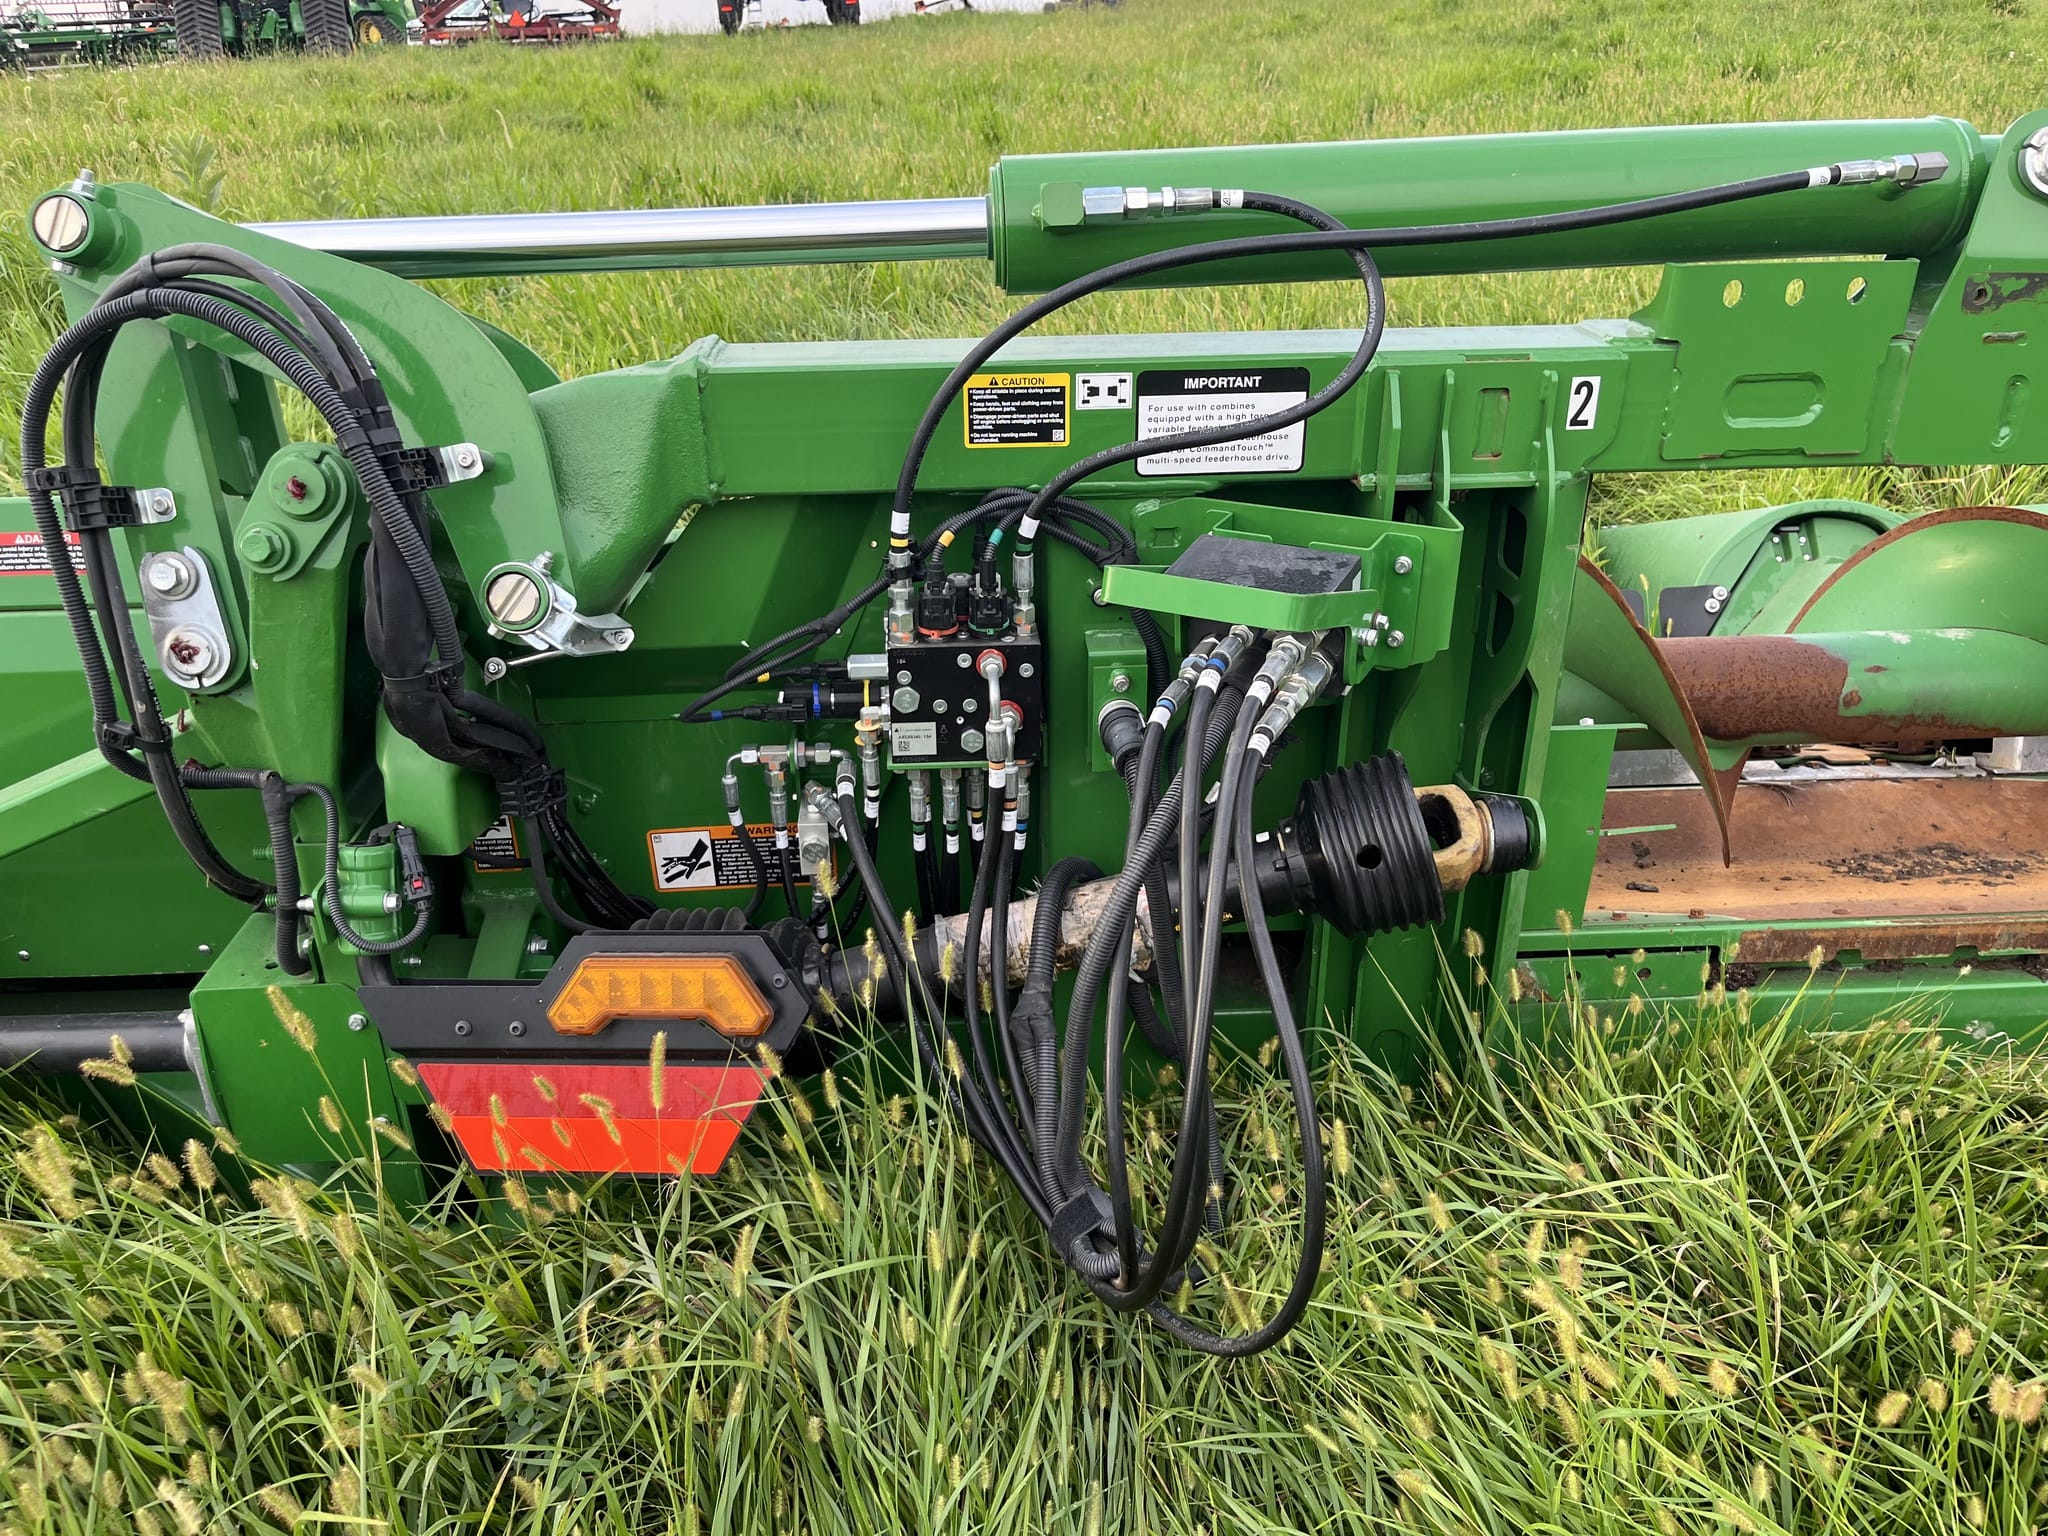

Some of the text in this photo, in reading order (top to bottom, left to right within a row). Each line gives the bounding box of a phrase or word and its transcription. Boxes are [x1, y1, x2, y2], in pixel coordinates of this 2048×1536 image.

[1002, 378, 1044, 386] CAUTION
[1184, 376, 1262, 389] IMPORTANT
[1569, 380, 1594, 426] 2
[1148, 415, 1191, 424] equipped
[1227, 413, 1246, 422] high
[1146, 456, 1201, 464] multi-speed
